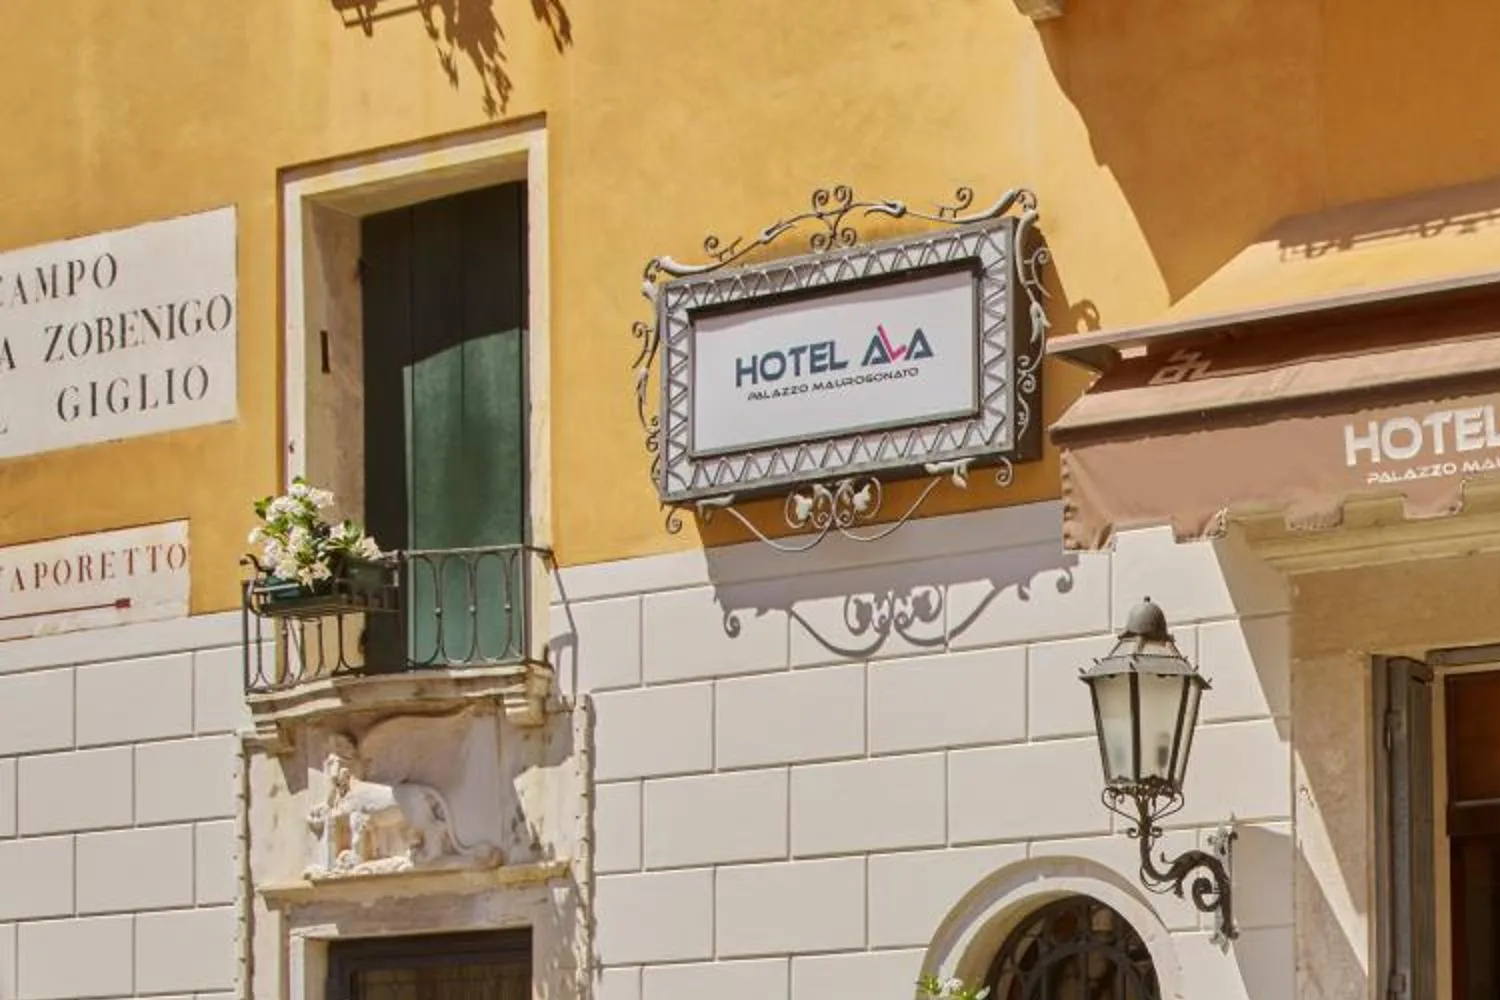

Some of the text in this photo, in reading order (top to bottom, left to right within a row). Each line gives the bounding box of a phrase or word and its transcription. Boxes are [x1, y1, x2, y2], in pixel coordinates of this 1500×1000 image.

[0, 253, 118, 306] AMPO
[44, 293, 232, 363] ZOBENIGO
[735, 323, 934, 388] HOTEL ALA
[57, 364, 209, 423] GIGLIO
[747, 367, 919, 401] PALAZZO MAUROGONATO
[1367, 462, 1457, 485] PALAZZO
[0, 543, 187, 592] APORETTO
